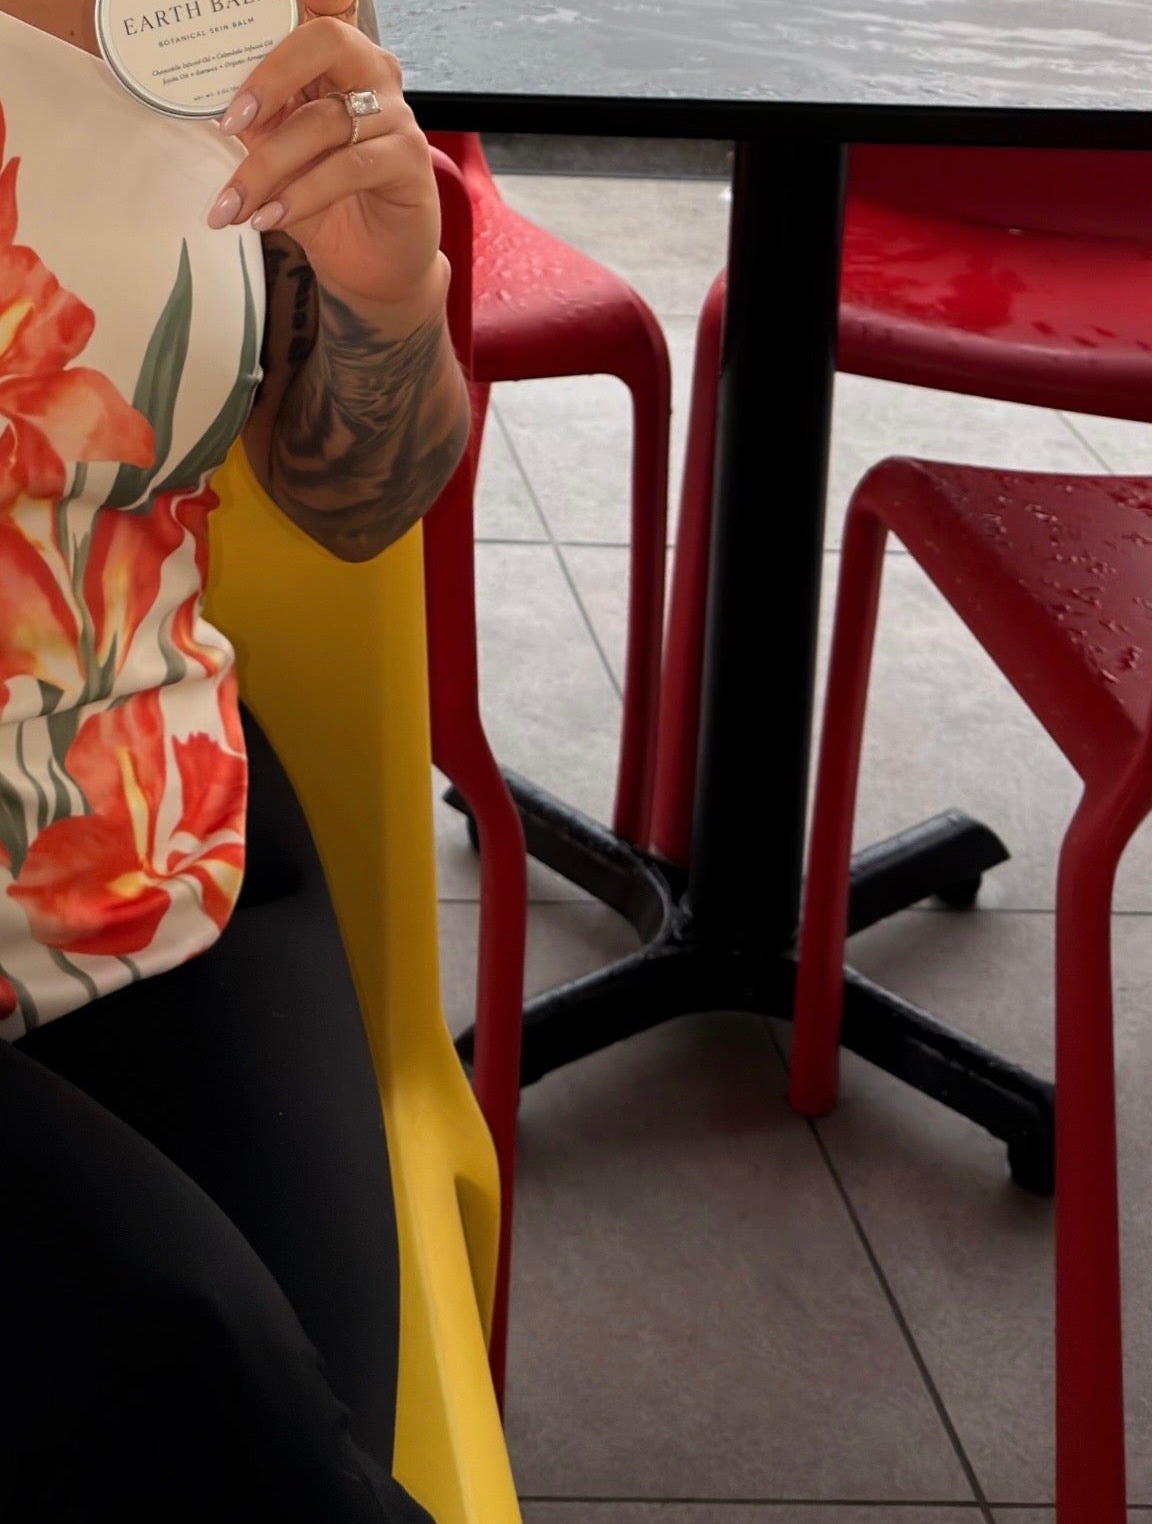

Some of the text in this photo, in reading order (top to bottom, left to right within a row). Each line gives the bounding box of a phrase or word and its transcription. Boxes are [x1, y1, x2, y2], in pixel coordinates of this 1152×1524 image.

[123, 0, 202, 36] EARTH
[158, 17, 254, 48] BOTANICAL SKIN BALM
